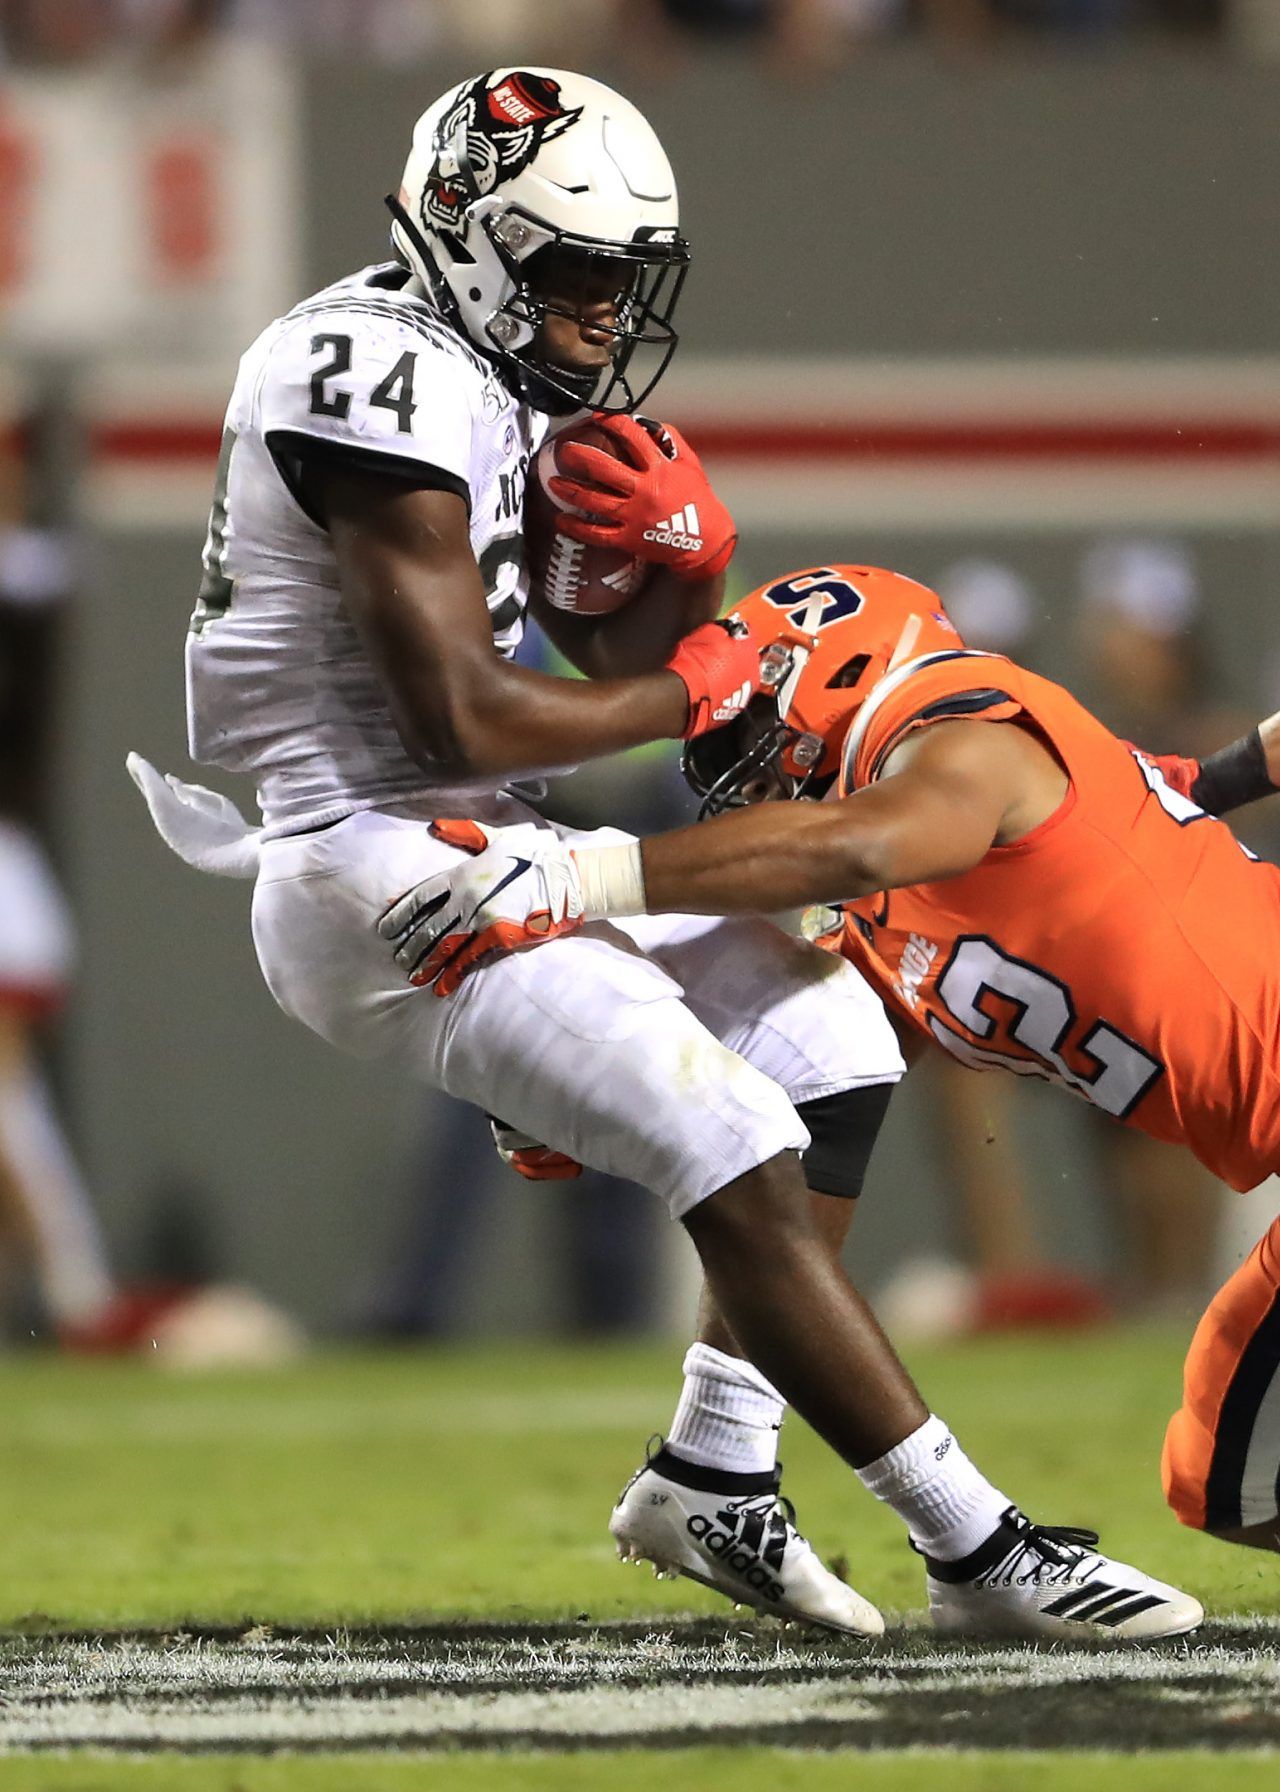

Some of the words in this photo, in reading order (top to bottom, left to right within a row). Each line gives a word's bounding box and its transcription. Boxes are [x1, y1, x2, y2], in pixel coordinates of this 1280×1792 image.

[500, 96, 536, 123] STATE
[309, 332, 418, 437] 24
[642, 529, 704, 551] adidas
[761, 567, 866, 630] S
[686, 1514, 785, 1604] adidas
